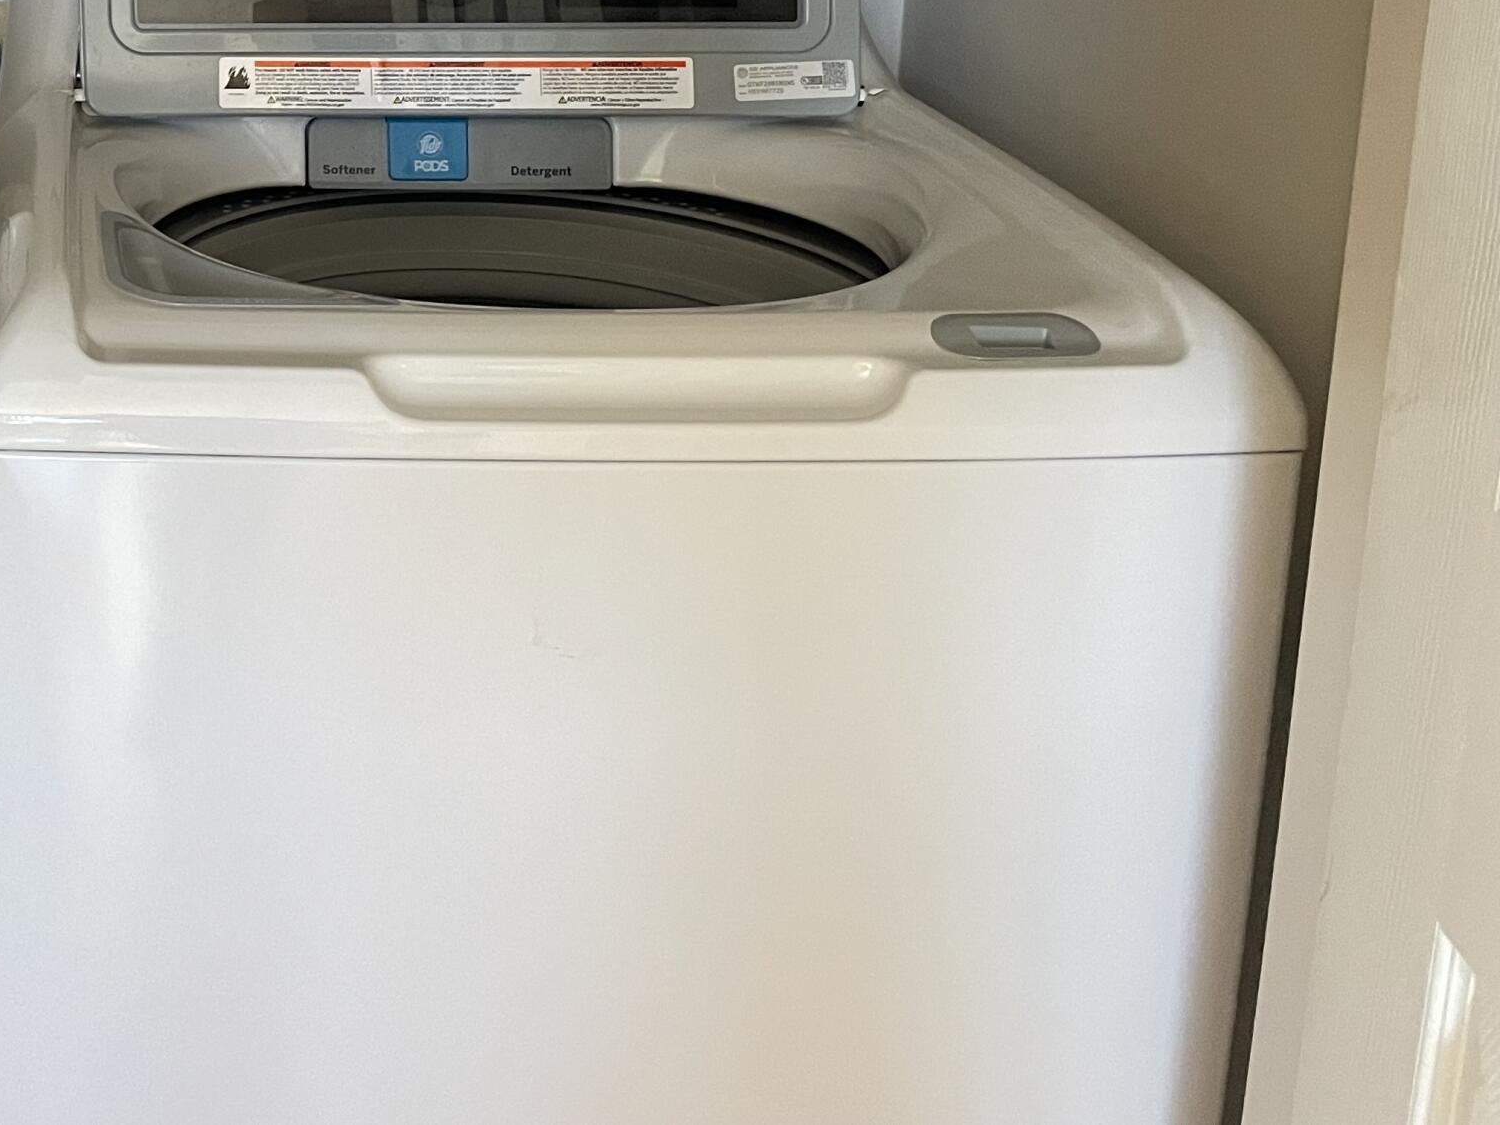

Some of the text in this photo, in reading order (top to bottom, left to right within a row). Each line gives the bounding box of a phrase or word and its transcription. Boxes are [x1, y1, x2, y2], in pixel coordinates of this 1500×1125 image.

[323, 164, 376, 175] Softener
[414, 160, 449, 172] PODS
[511, 166, 572, 178] Detergent
